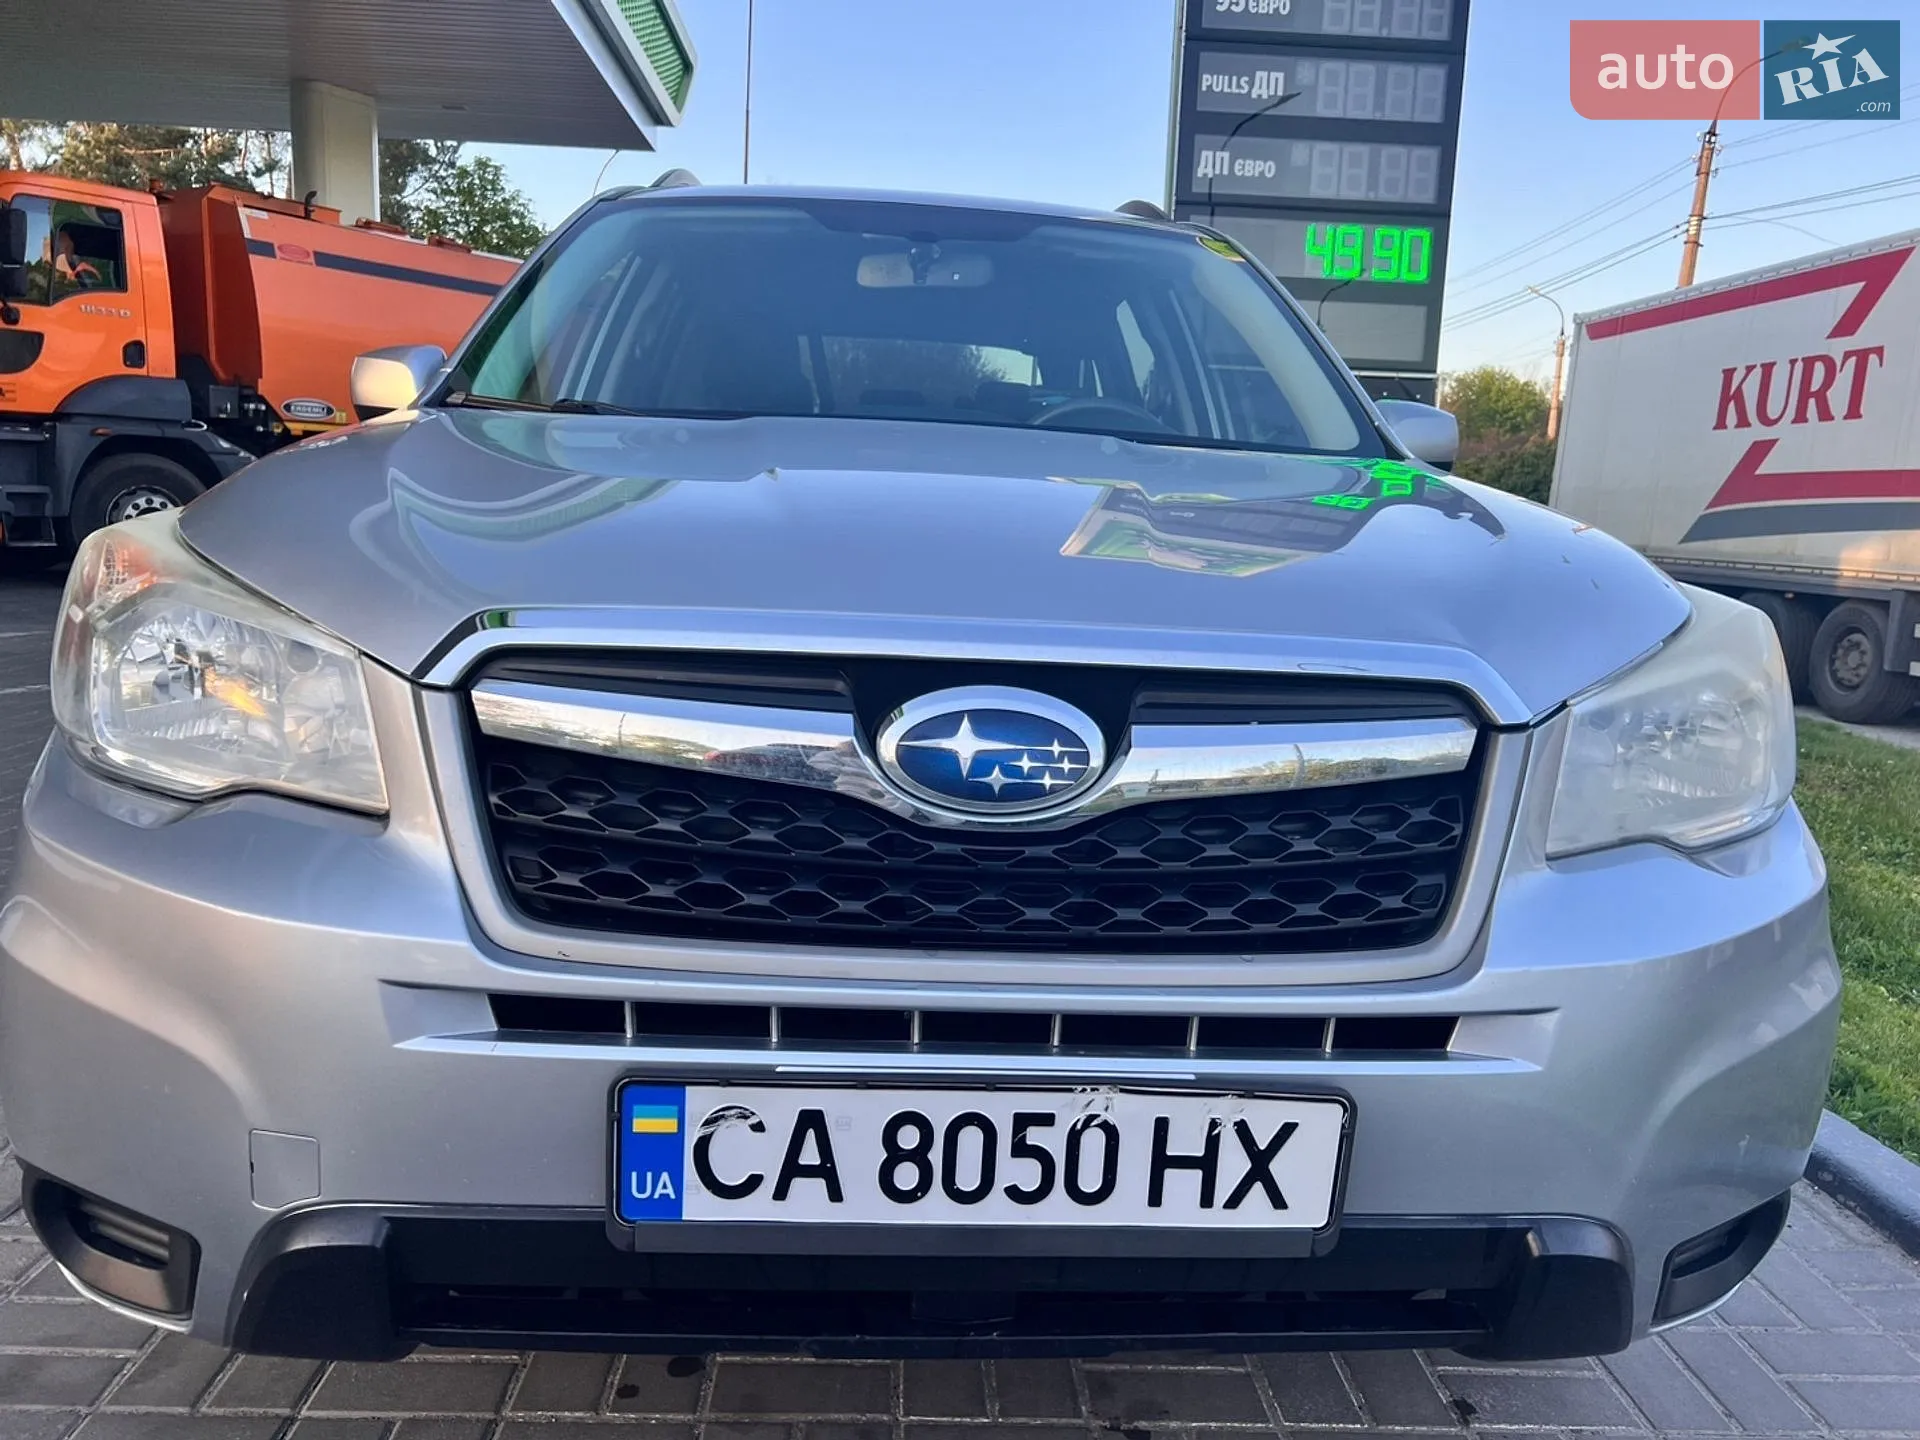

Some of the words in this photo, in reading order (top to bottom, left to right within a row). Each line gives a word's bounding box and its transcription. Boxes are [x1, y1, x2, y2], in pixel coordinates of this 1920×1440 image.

[1201, 74, 1250, 94] PULLS
[1251, 70, 1285, 99] ДП
[1197, 150, 1230, 178] ДП
[1712, 345, 1885, 432] KURT
[692, 1104, 845, 1203] CA
[878, 1109, 1121, 1207] 8050
[1147, 1115, 1300, 1211] HX
[630, 1170, 677, 1200] UA
